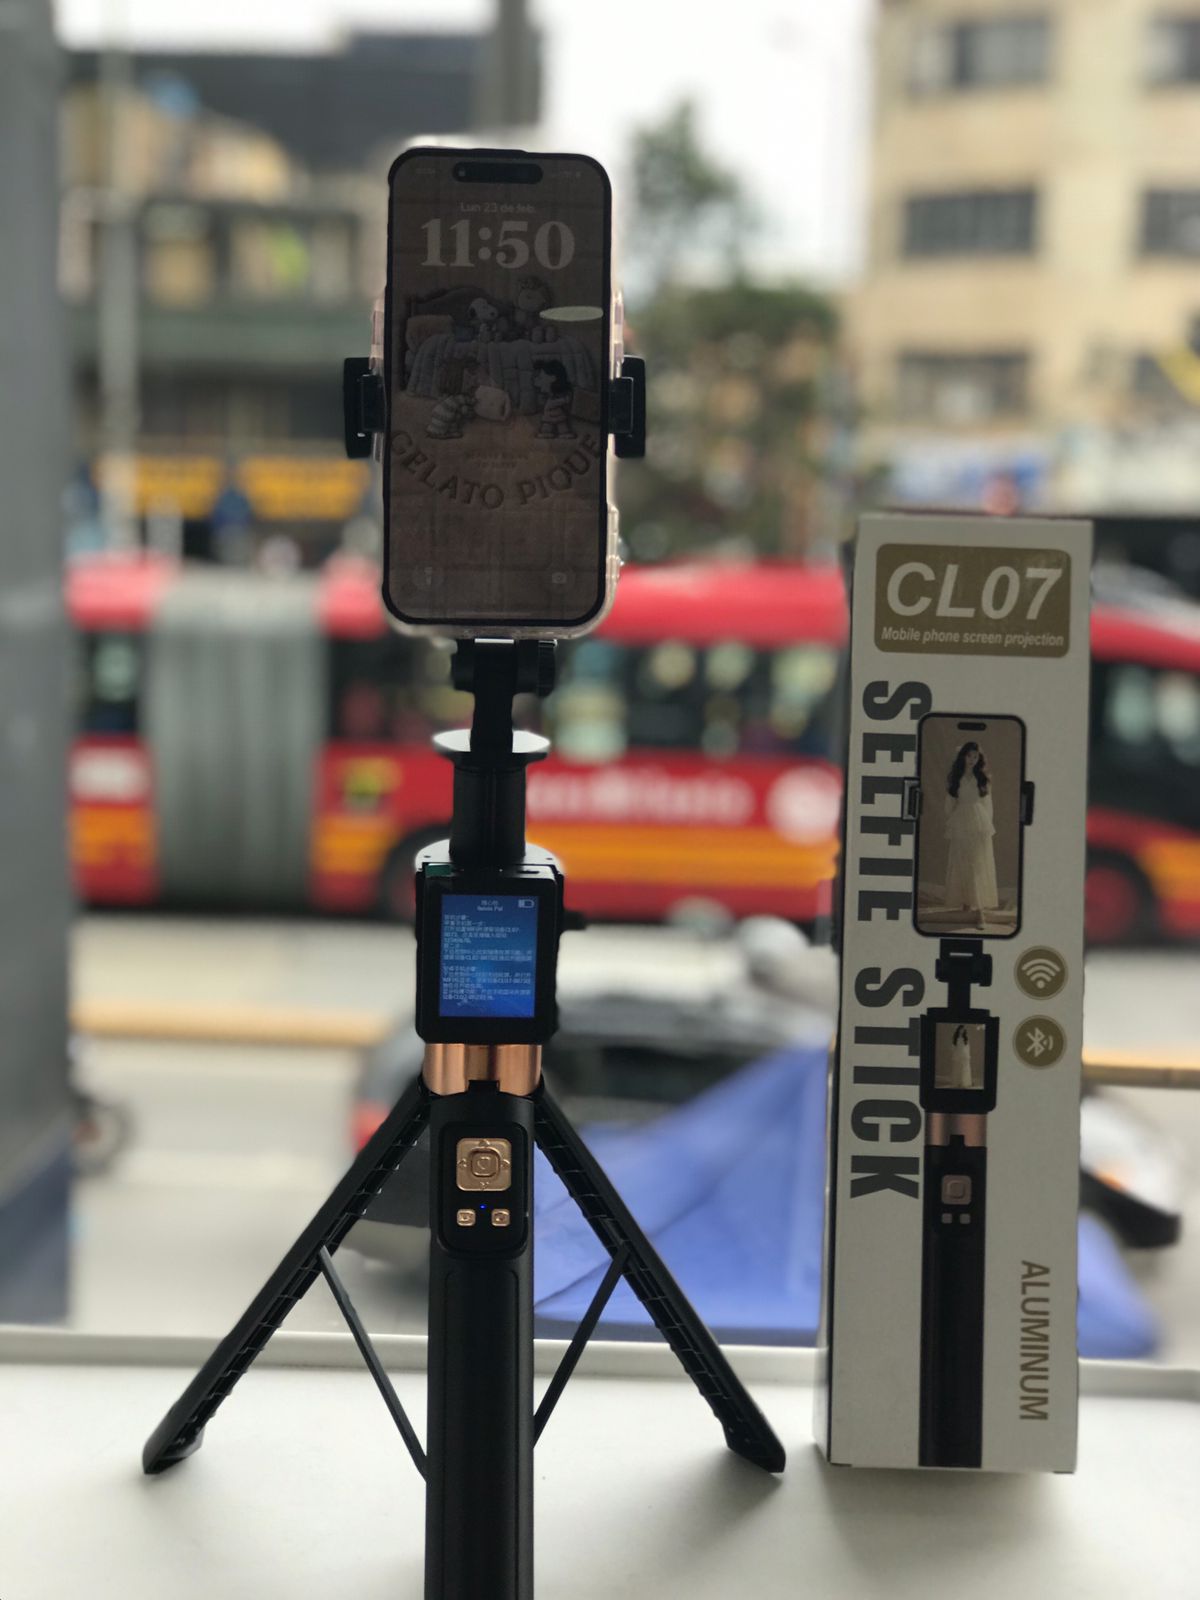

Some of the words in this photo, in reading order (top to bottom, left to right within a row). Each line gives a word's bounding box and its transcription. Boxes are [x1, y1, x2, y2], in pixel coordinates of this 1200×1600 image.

[460, 202, 481, 212] Lun
[484, 202, 498, 213] 23
[421, 218, 575, 270] 11:50
[391, 430, 504, 509] GELATO
[516, 433, 600, 505] PIQUE
[887, 562, 1063, 620] CL07
[881, 626, 920, 641] Mobile
[922, 628, 960, 644] phone
[963, 630, 1001, 645] screen
[1004, 632, 1064, 648] projection
[850, 967, 925, 1200] STICK
[1019, 1260, 1051, 1421] ALUMINUM
